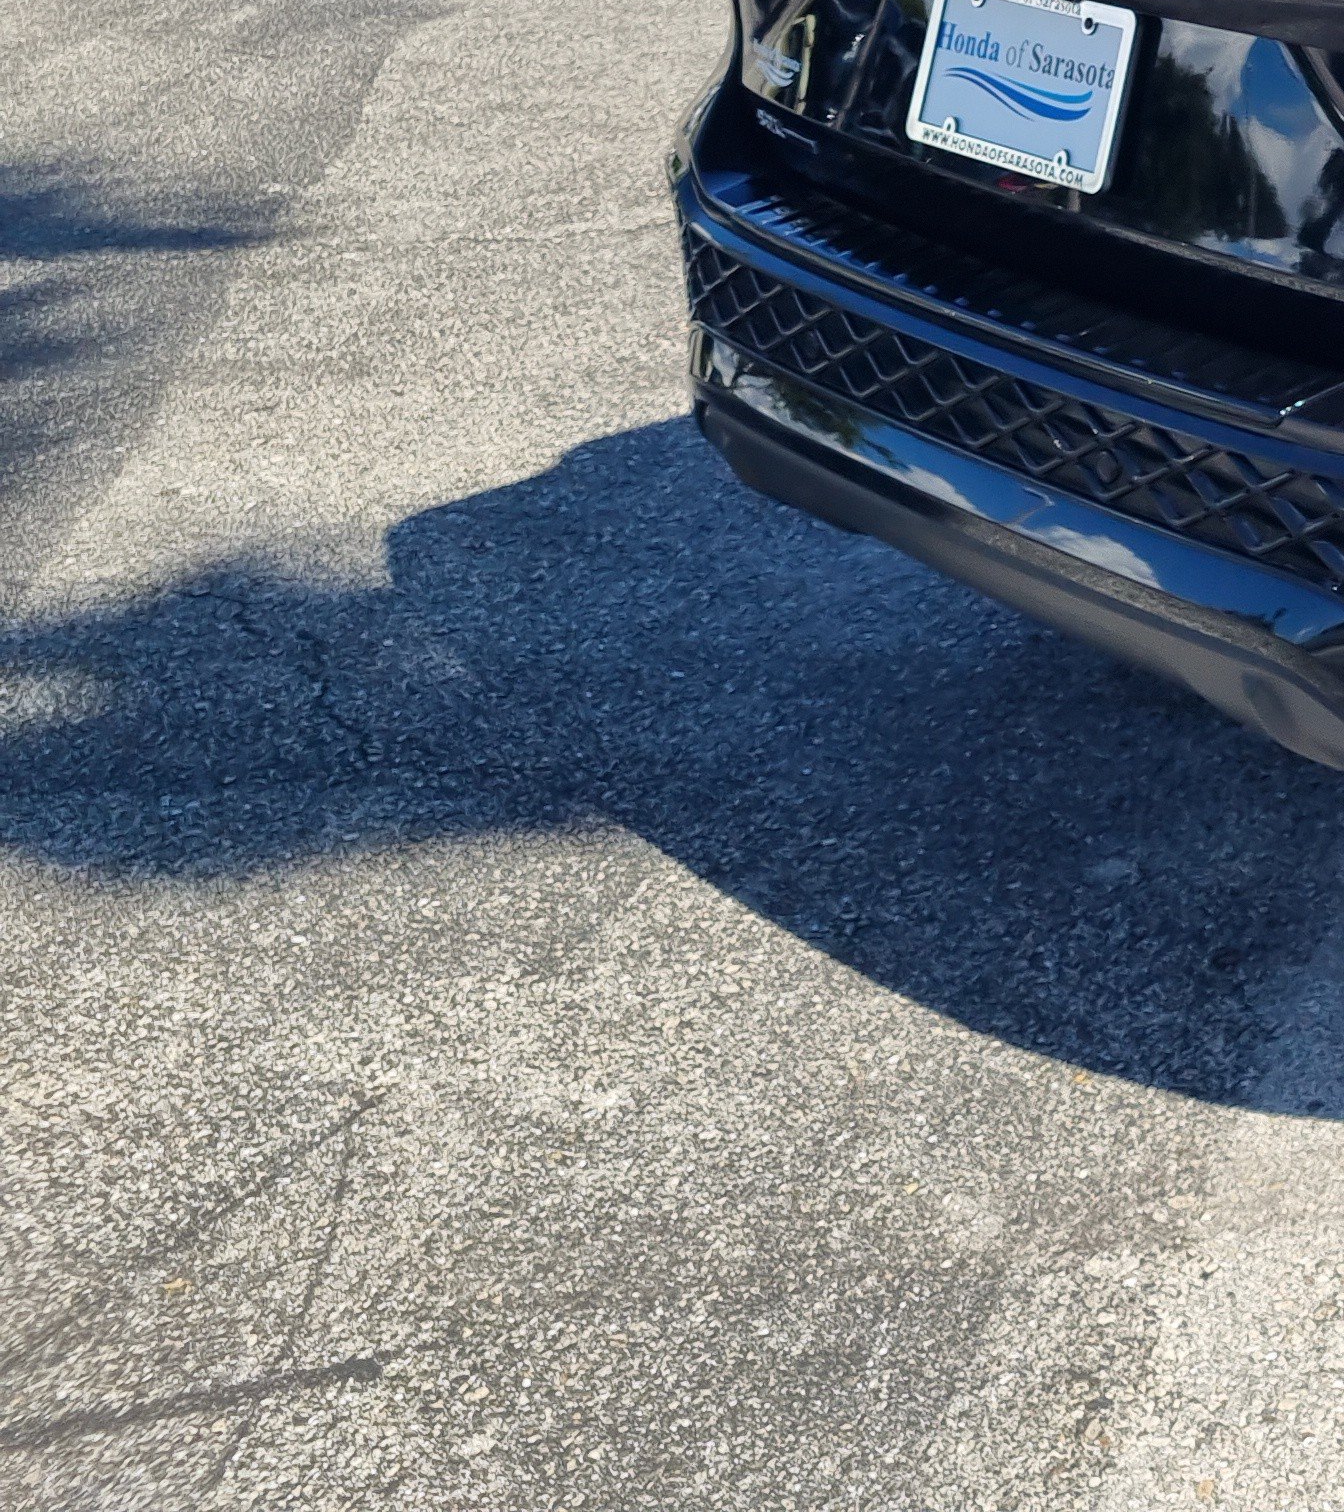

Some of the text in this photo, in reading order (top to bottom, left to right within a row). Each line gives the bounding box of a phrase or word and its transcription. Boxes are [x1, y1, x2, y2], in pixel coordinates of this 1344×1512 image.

[936, 20, 1116, 90] Honda of Sarasota
[922, 127, 1084, 186] WWW.HONDAOFSARASOTA.COM
